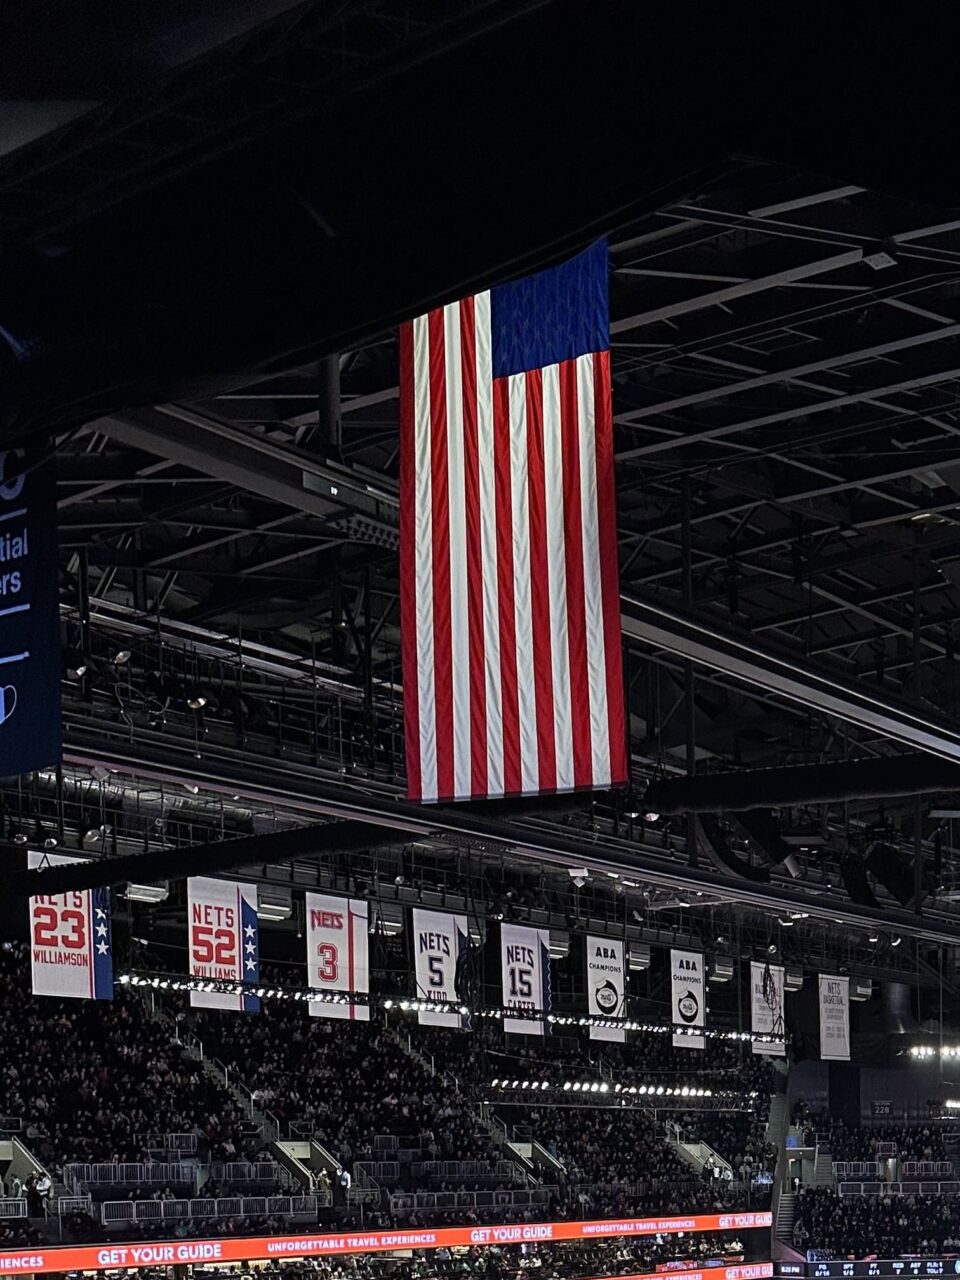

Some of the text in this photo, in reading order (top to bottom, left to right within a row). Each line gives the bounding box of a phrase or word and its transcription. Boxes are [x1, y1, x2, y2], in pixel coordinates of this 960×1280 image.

[192, 903, 234, 928] NETS
[310, 909, 344, 930] NETS
[33, 907, 86, 949] 23
[192, 926, 236, 965] 52
[419, 932, 451, 957] NETS
[595, 947, 617, 960] ABA
[33, 949, 88, 967] WILLIAMSON
[317, 942, 339, 982] 3
[506, 945, 534, 969] NETS
[589, 963, 622, 973] CHAMPIONS
[678, 959, 698, 972] ABA
[193, 965, 236, 980] WILLIAMS
[428, 956, 444, 987] 5
[509, 967, 532, 997] 15
[673, 974, 702, 984] CHAMPIONS
[98, 1250, 127, 1266] GET
[128, 1246, 175, 1264] YOUR
[177, 1244, 222, 1260] GUIDE
[267, 1238, 346, 1252] UNFORGETTABLE
[347, 1236, 379, 1248] TRAVEL
[381, 1233, 436, 1246] EXPERIENCES
[471, 1229, 493, 1242] GET
[493, 1227, 522, 1241] YOUR
[523, 1226, 553, 1239] GUIDE
[583, 1222, 634, 1234] UNFORGETTABLE
[634, 1221, 657, 1232] TRAVEL
[658, 1220, 696, 1230] EXPERIENCES
[719, 1216, 734, 1227] GET
[734, 1215, 754, 1227] YOUR
[725, 1268, 742, 1279] GET
[742, 1267, 760, 1279] YOUR
